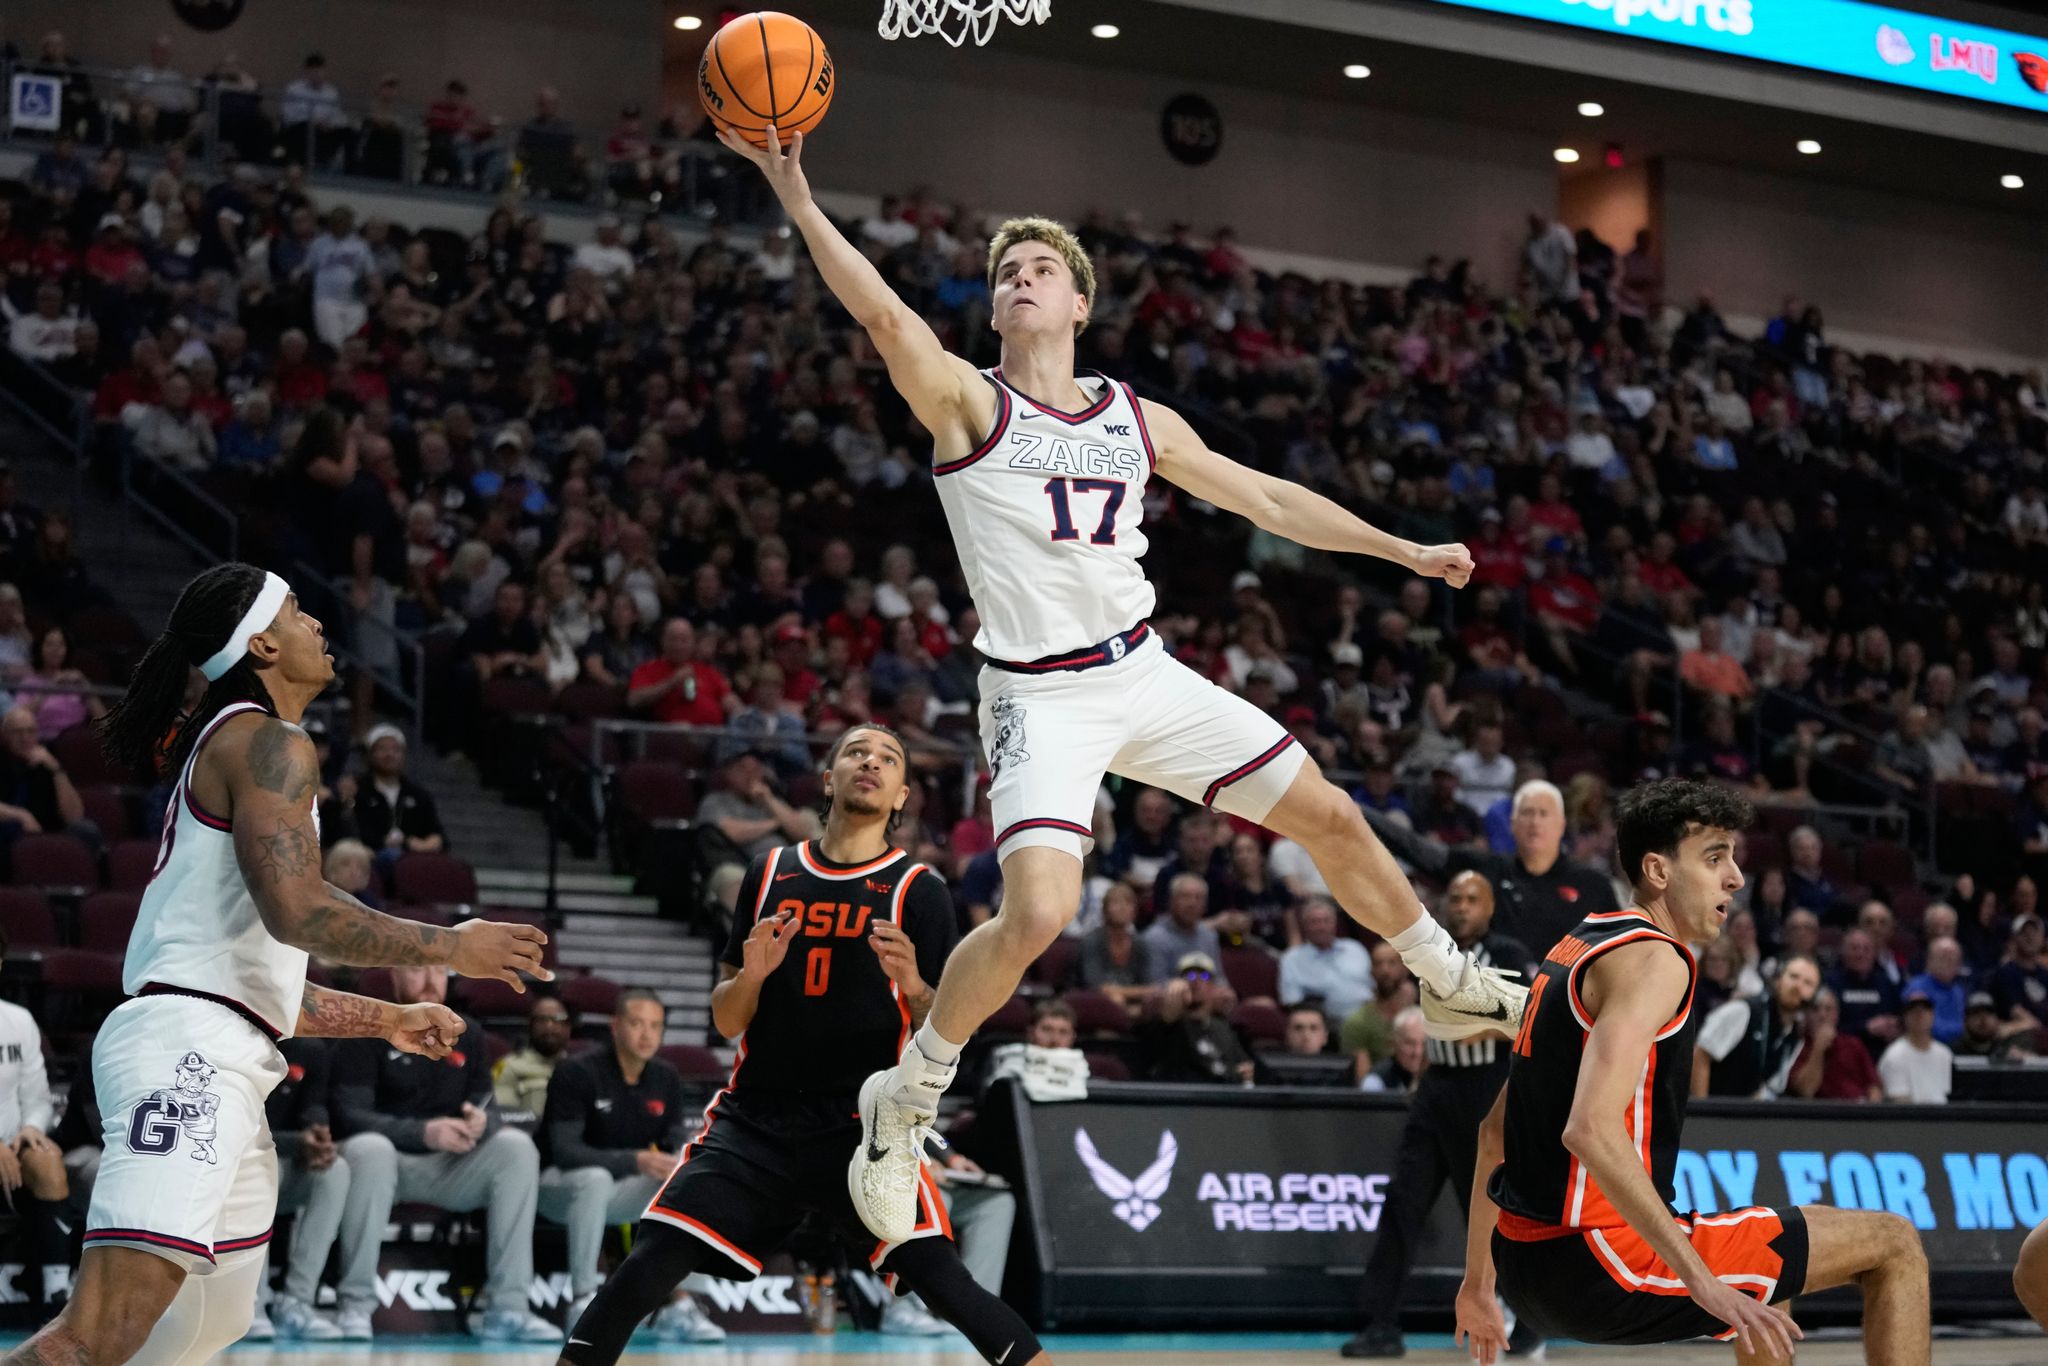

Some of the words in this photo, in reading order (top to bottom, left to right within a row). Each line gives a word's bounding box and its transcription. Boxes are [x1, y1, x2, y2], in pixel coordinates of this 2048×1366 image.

[1930, 33, 1998, 84] LMU
[1104, 424, 1130, 436] WCC
[1009, 432, 1141, 481] ZAGS
[1044, 477, 1127, 546] 17
[1109, 636, 1126, 660] G
[773, 899, 872, 938] OSU
[804, 947, 832, 996] 0
[126, 1097, 182, 1156] G
[1198, 1172, 1274, 1201] AIR
[1280, 1173, 1391, 1202] FORC
[1673, 1150, 1759, 1213] DY
[1779, 1151, 1936, 1229] FOR
[1942, 1153, 2048, 1230] MO
[1212, 1202, 1384, 1231] RESERV
[705, 1275, 803, 1314] WCC
